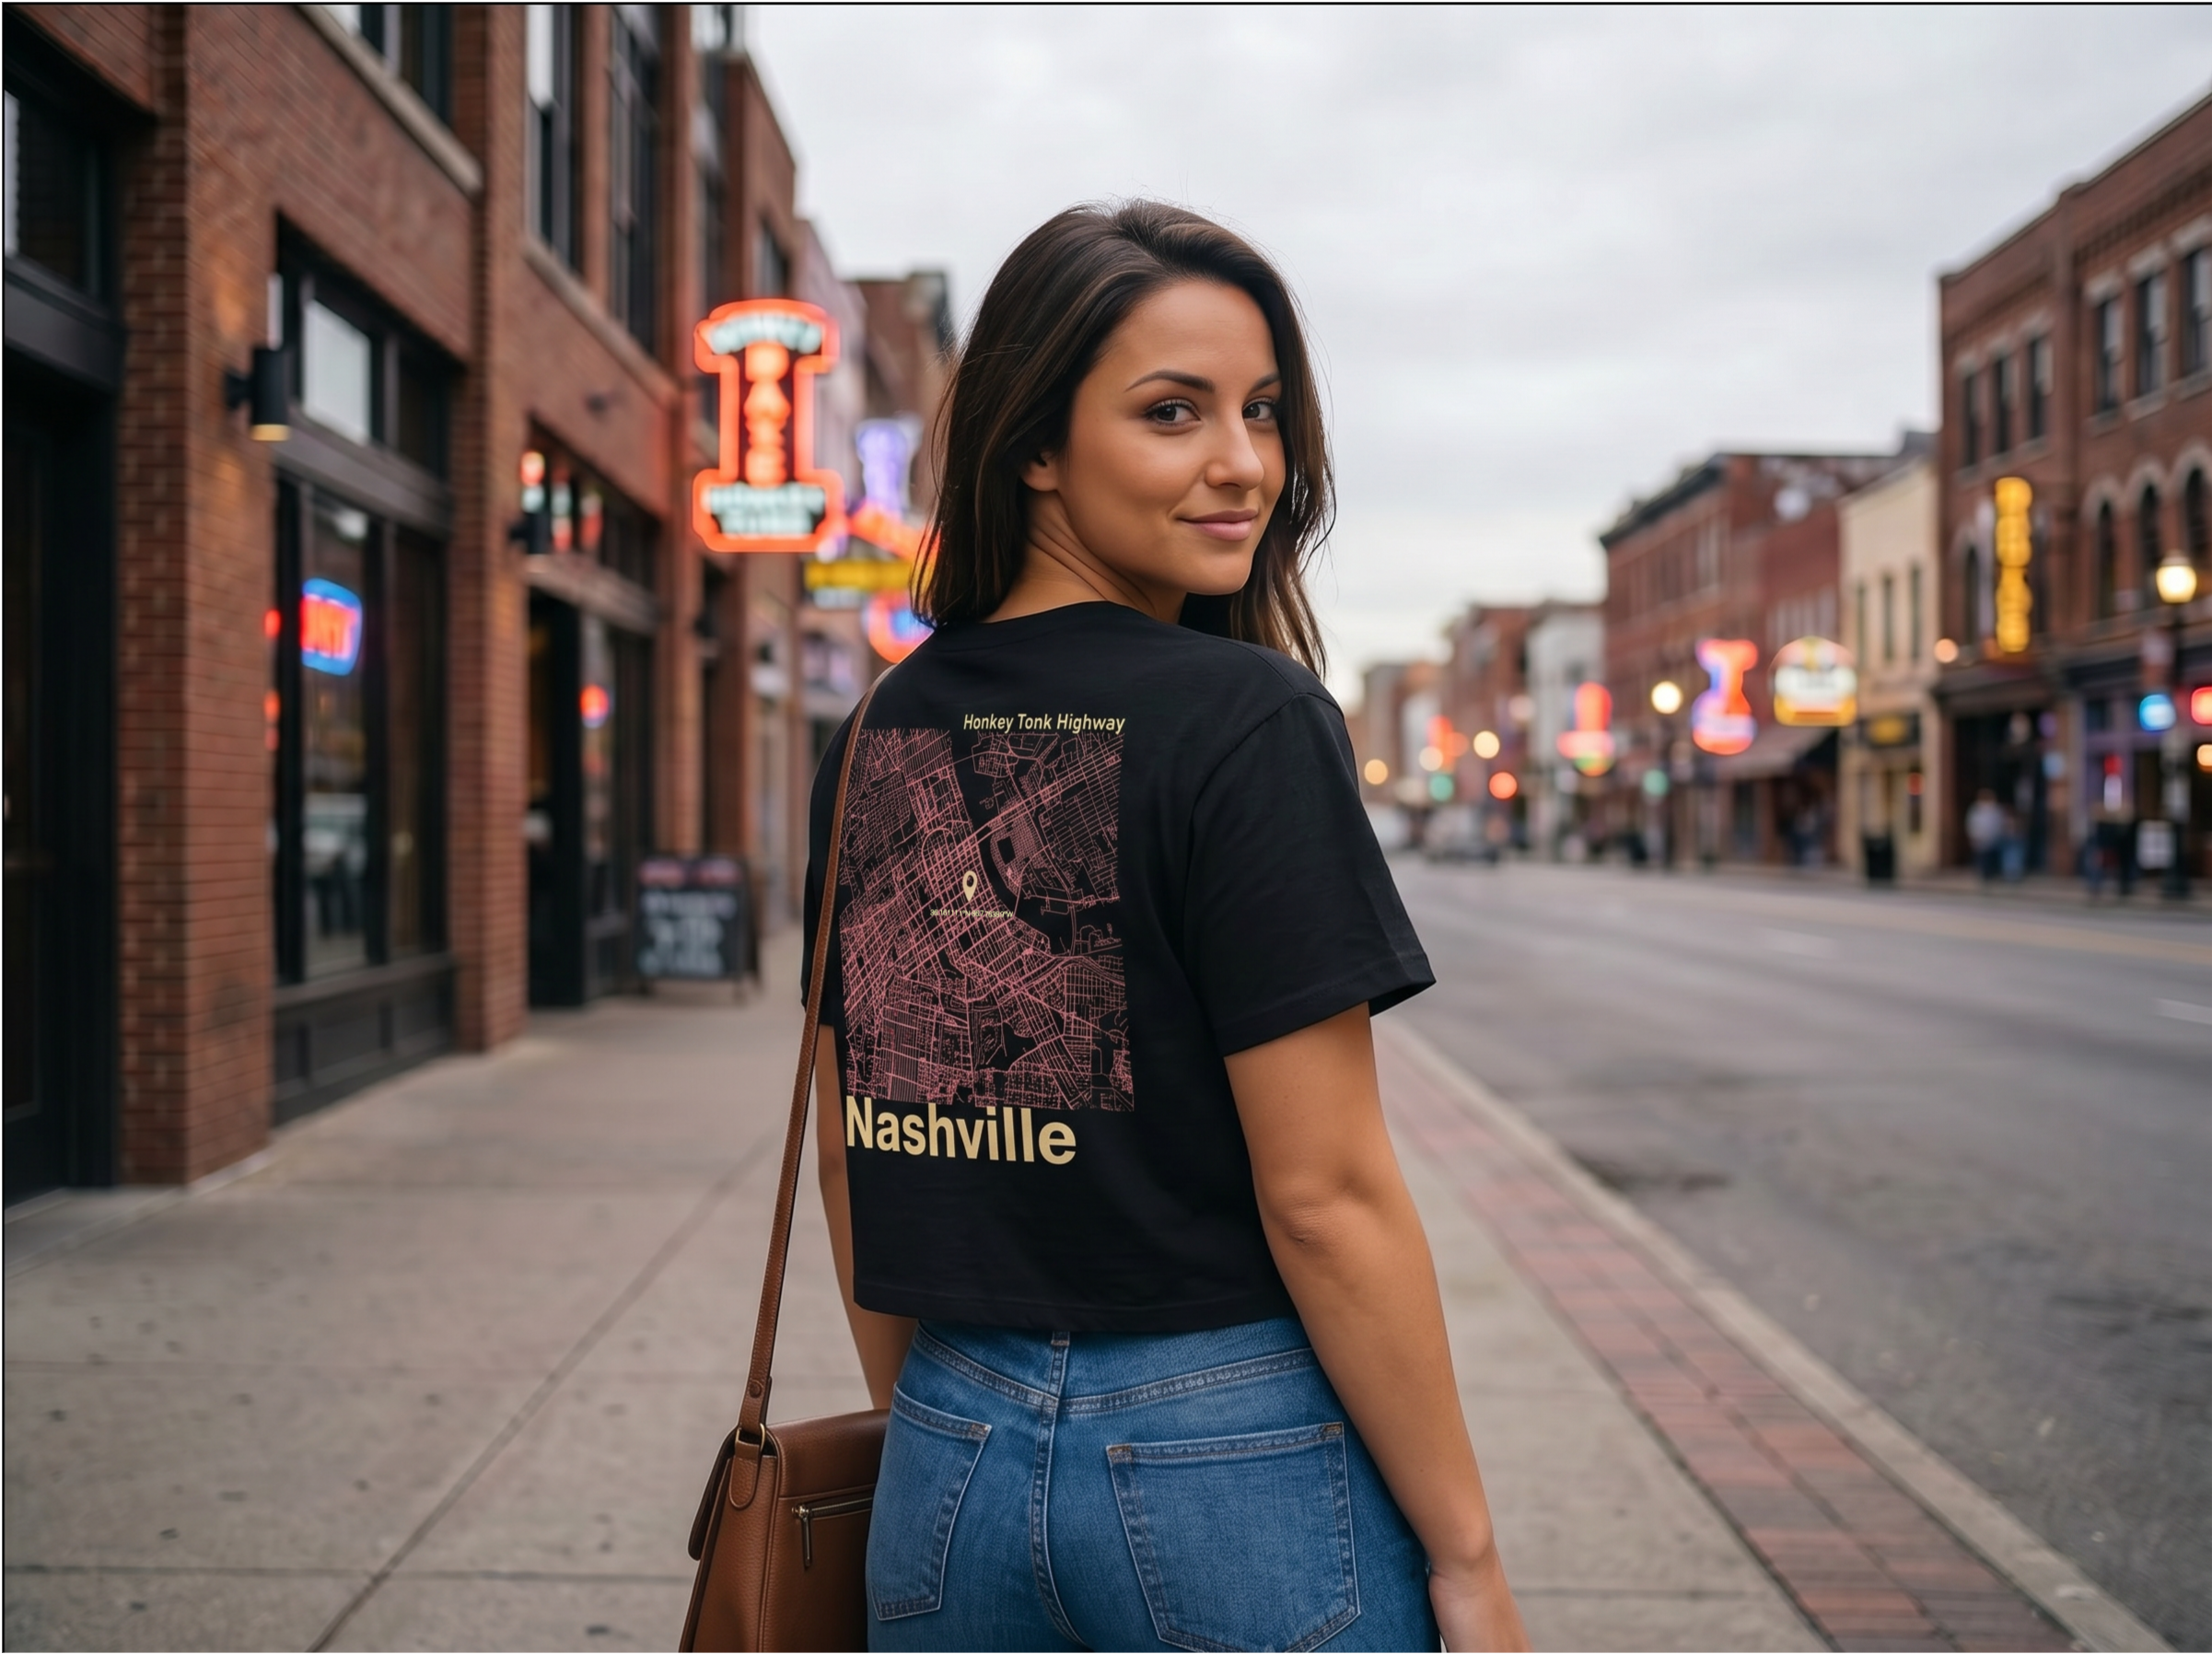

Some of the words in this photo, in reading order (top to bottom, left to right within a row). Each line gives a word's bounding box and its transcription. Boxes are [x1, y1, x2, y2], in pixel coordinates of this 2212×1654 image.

[963, 714, 1014, 733] Honkey
[1018, 713, 1052, 729] Tonk
[1056, 713, 1125, 734] Highway
[845, 1095, 1077, 1165] Nashville
